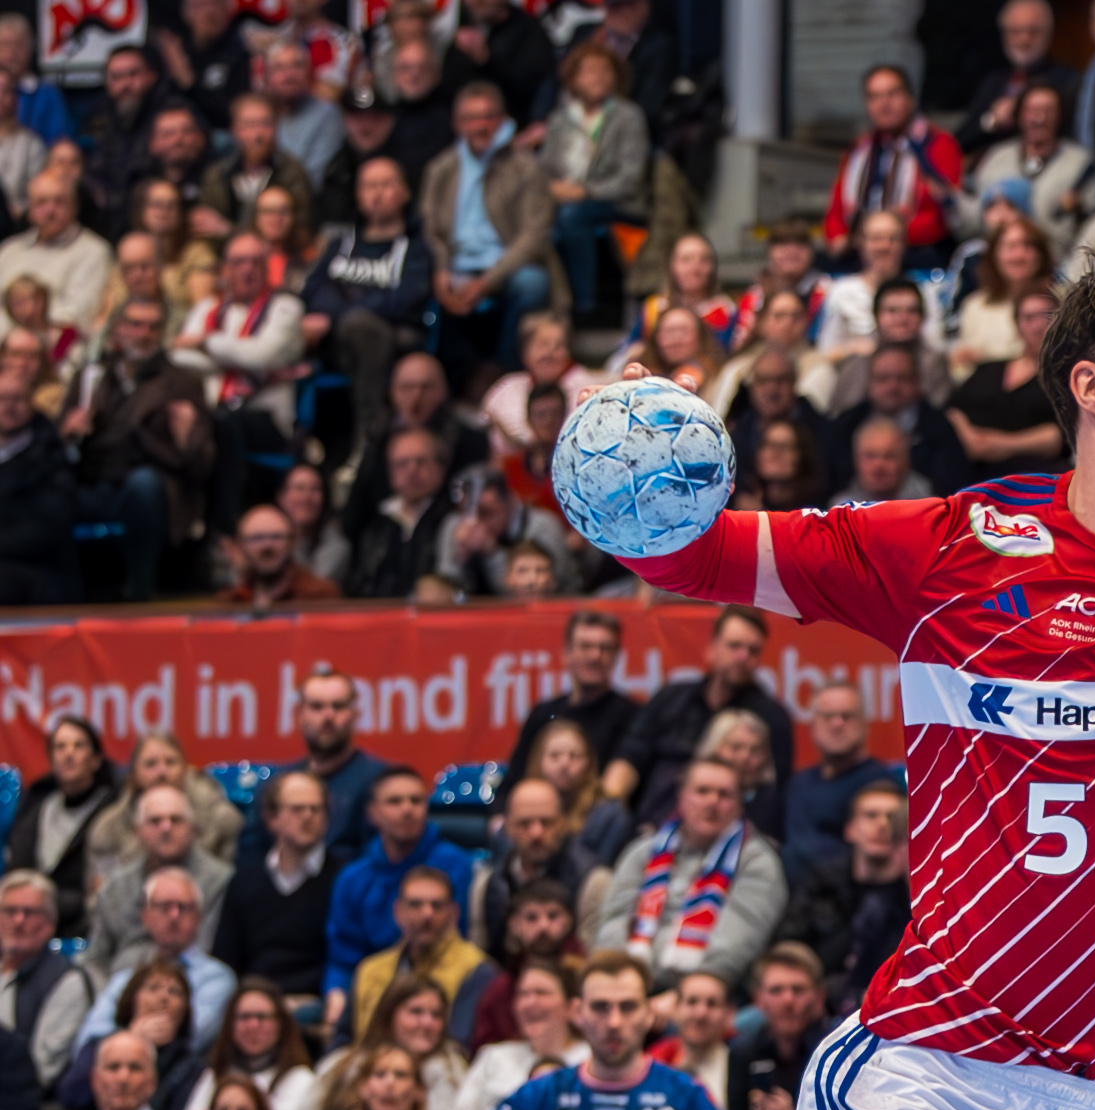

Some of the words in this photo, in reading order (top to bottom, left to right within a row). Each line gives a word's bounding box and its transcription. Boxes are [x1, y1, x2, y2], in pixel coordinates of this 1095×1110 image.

[1050, 618, 1072, 630] AOK
[1048, 627, 1064, 637] Die
[195, 664, 258, 738] in
[611, 646, 901, 723] Hbur
